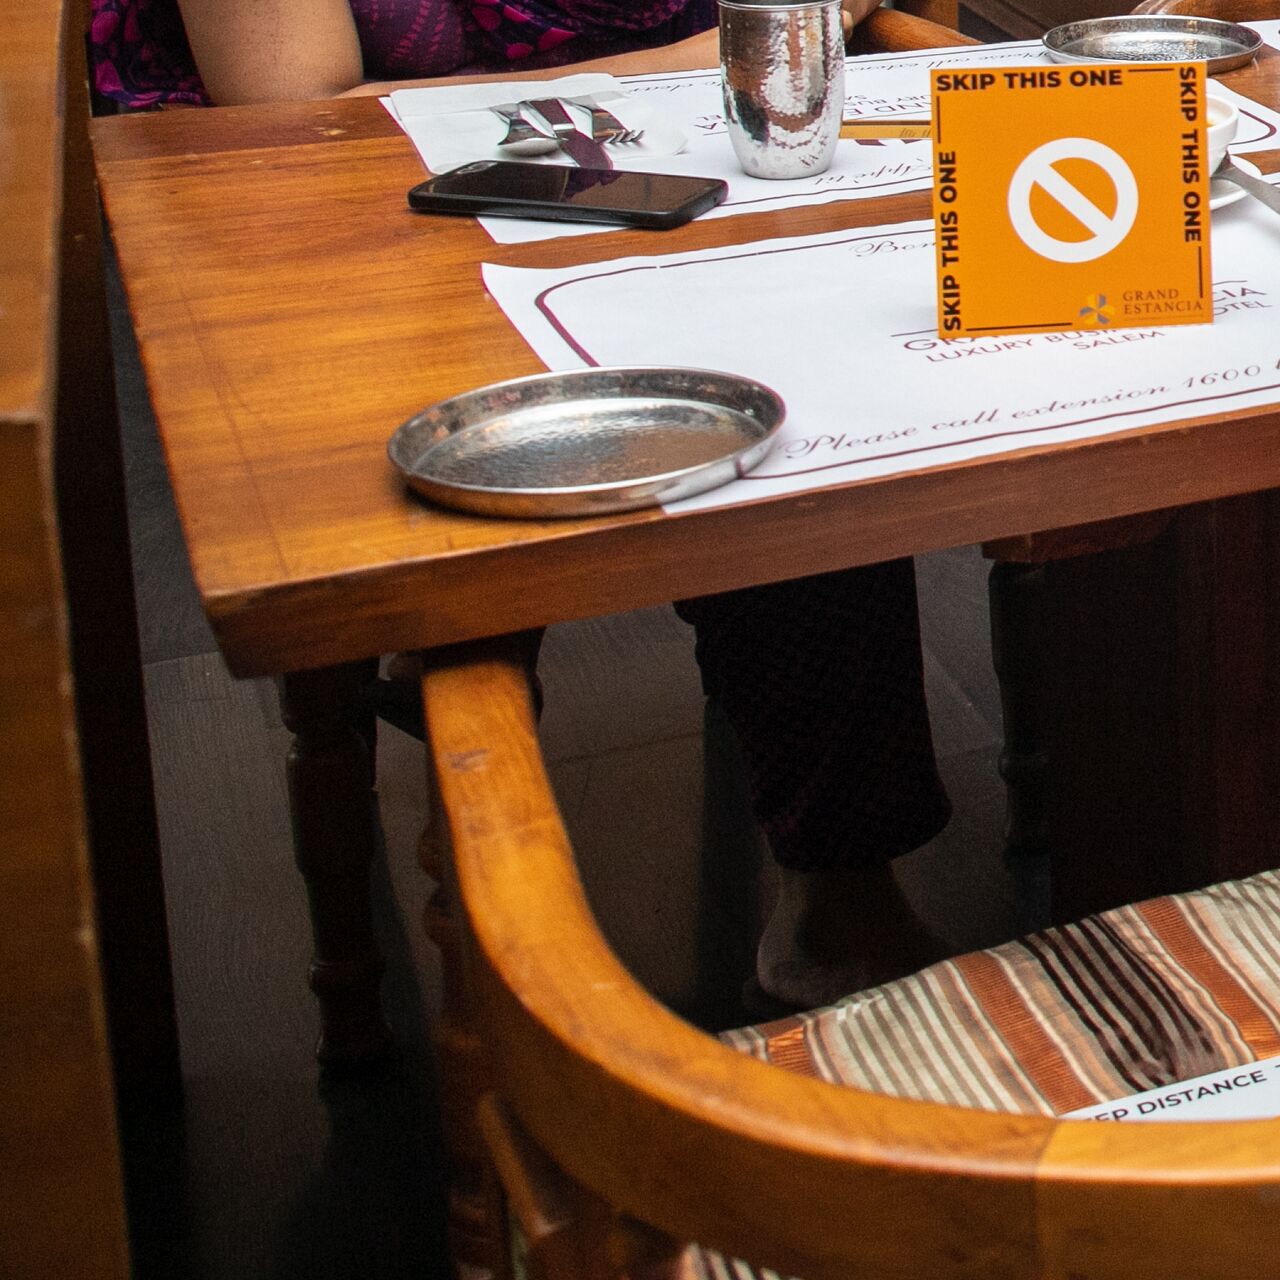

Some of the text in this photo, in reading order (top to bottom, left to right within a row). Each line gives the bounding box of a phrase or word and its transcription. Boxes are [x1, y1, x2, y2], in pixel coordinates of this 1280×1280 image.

[936, 70, 1122, 91] SKIP THIS ONE
[1179, 66, 1202, 242] SKIP THIS ONE
[938, 151, 961, 331] SKIP THIS ONE
[1122, 288, 1179, 302] GRAND
[1123, 300, 1203, 315] ESTANCIA
[926, 338, 1033, 363] LUXURY
[1213, 300, 1273, 316] OTEL
[1073, 331, 1165, 350] SALEM
[778, 433, 919, 459] Please
[931, 408, 999, 431] call
[1011, 385, 1170, 419] extension
[1183, 365, 1261, 388] 1600
[1137, 1070, 1268, 1115] DISTANCE
